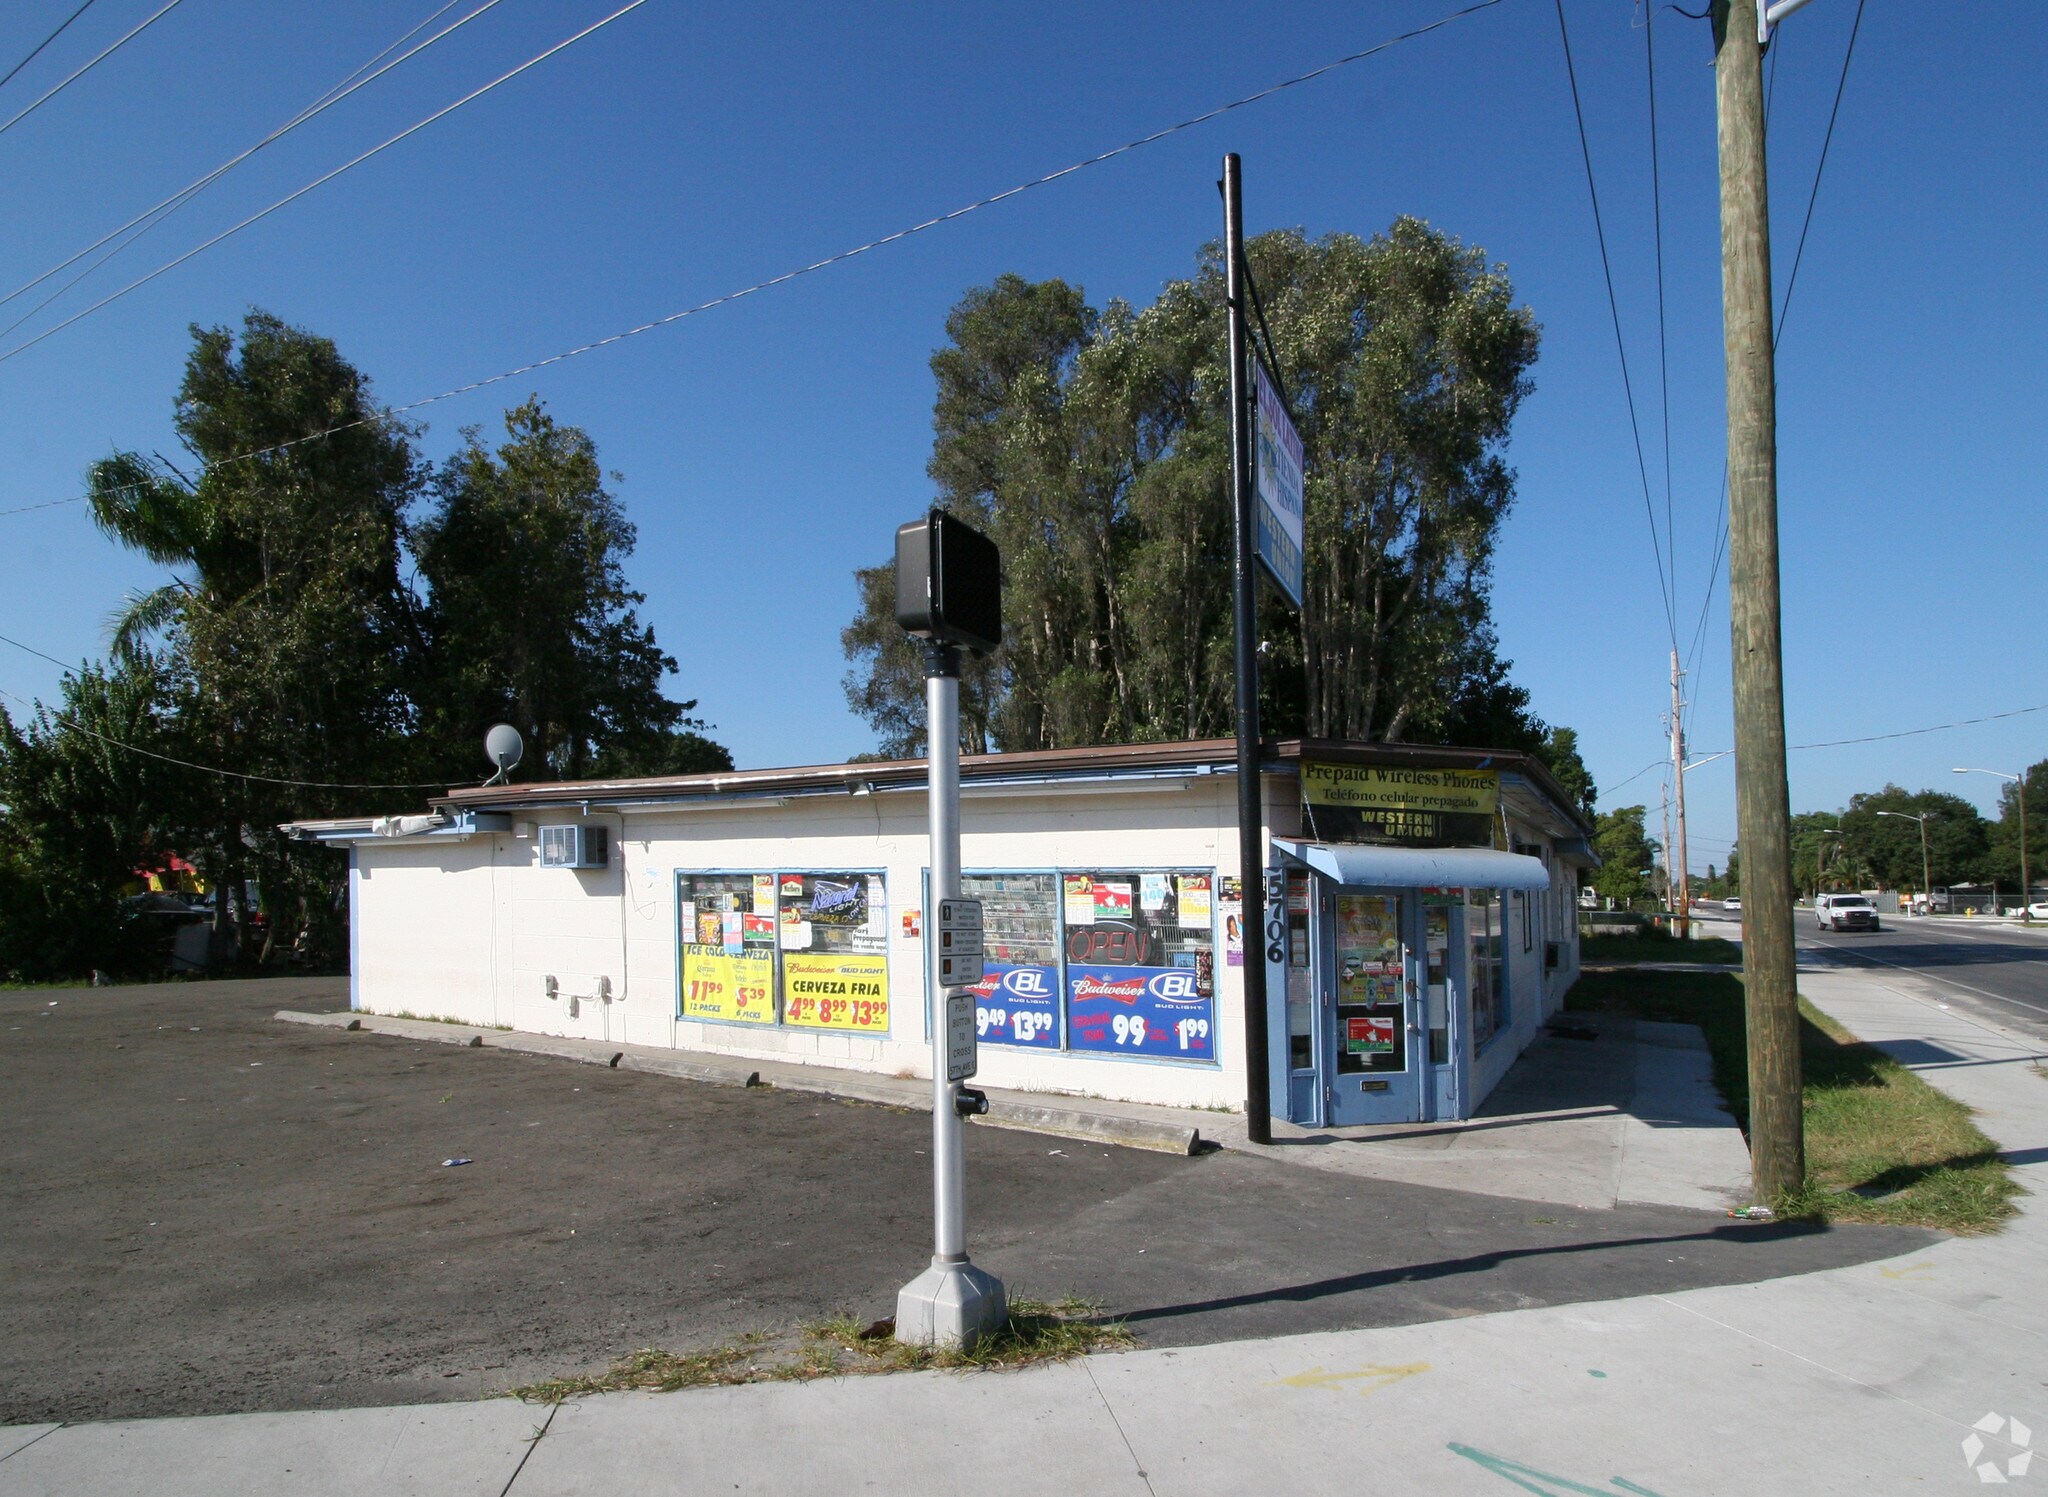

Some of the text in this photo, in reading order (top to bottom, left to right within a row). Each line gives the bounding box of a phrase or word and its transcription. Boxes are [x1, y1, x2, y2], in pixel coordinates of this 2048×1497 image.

[1259, 495, 1295, 568] WESTERN
[1272, 541, 1293, 590] UNION
[1306, 765, 1495, 790] Prepaid Wireless Phones
[1323, 788, 1478, 810] Teléfono celular prepagado
[1362, 811, 1432, 824] WESTERN
[1385, 824, 1432, 837] UNION
[829, 898, 860, 912] LIGHT
[1267, 874, 1284, 963] 5706
[687, 945, 702, 955] ICE
[1070, 931, 1146, 961] OPEN
[787, 963, 835, 974] Budweiser
[793, 980, 880, 995] CERVEZA FRIA
[1015, 973, 1048, 992] BL
[1072, 980, 1145, 995] Budweiser
[1163, 976, 1198, 996] BL
[700, 1004, 721, 1012] PACKS
[955, 1003, 968, 1012] PUSH
[952, 1017, 971, 1028] BUTTON
[959, 1032, 965, 1041] TO
[953, 1046, 971, 1058] CROSS
